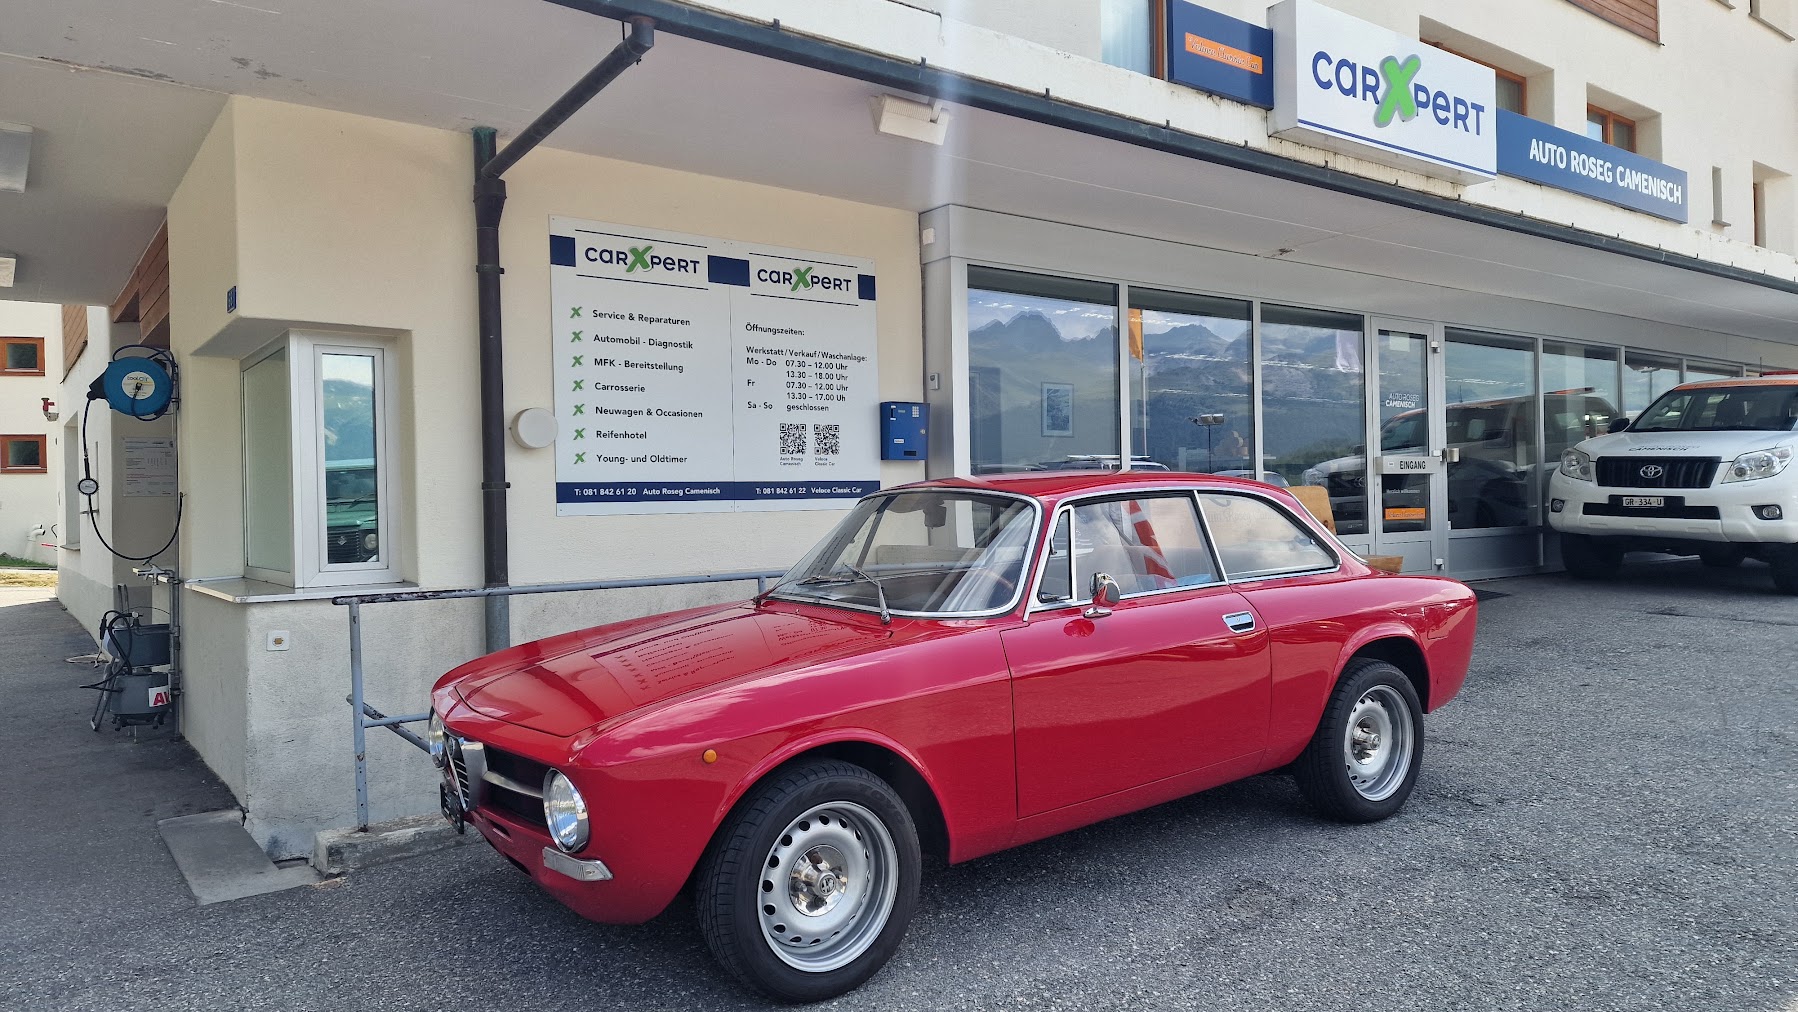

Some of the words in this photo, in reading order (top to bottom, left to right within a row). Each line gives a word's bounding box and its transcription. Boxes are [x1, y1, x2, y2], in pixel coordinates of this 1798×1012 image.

[1529, 138, 1567, 169] AUTO
[1570, 150, 1613, 183] ROSEG
[1616, 165, 1682, 204] CAMENISCH
[592, 309, 625, 320] Service
[628, 312, 635, 321] &
[638, 313, 691, 326] Reparaturen
[745, 321, 805, 336] Öffnungszeiten:
[593, 334, 641, 345] Automobil
[648, 338, 693, 350] Diagnostik
[594, 358, 616, 367] MFK
[624, 360, 684, 373] Bereitstellung
[746, 357, 759, 365] Mo
[766, 358, 777, 366] Do
[785, 359, 806, 368] 07.30
[814, 362, 834, 370] 12.00
[835, 362, 848, 370] Uhr
[786, 370, 807, 379] 13.30
[815, 372, 834, 380] 18.00
[835, 373, 849, 381] Uhr
[594, 382, 646, 393] Carrosserie
[747, 379, 756, 387] Fr
[785, 381, 807, 389] 07.30
[815, 383, 834, 391] 12.00
[786, 392, 807, 400] 13.30
[815, 393, 835, 401] 17.00
[836, 394, 846, 402] Uh
[747, 401, 757, 409] Sa
[763, 401, 773, 409] So
[786, 403, 830, 412] geschlossen
[1385, 400, 1416, 408] CAMENISCH
[595, 406, 644, 418] Neuwagen
[646, 408, 653, 416] &
[655, 408, 703, 418] Occasionen
[596, 430, 647, 439] Reifenhotel
[596, 454, 629, 465] Young-
[630, 454, 647, 463] und
[650, 454, 688, 463] Oldtimer
[1399, 460, 1426, 470] EINGANG
[574, 488, 581, 496] T:
[583, 488, 597, 496] 081
[600, 488, 614, 496] 842
[662, 488, 684, 496] Roseg
[685, 487, 721, 495] Camenisch
[755, 487, 762, 495] T:
[762, 487, 774, 495] 081
[776, 487, 788, 495] 842
[832, 486, 851, 494] Classic
